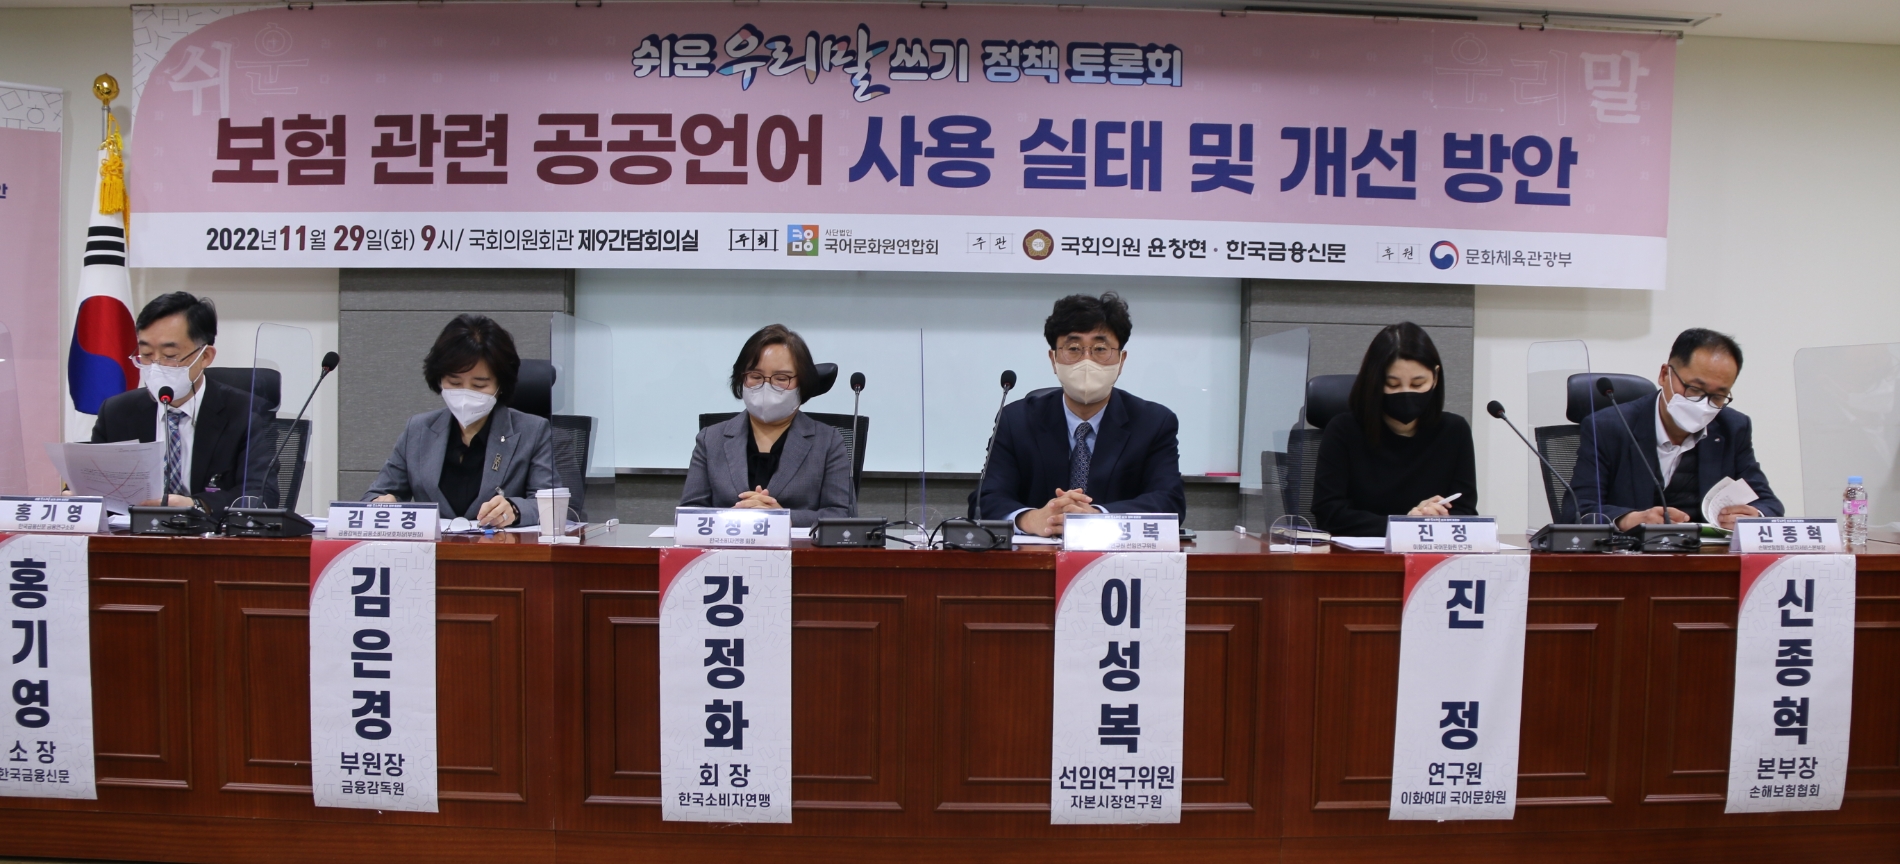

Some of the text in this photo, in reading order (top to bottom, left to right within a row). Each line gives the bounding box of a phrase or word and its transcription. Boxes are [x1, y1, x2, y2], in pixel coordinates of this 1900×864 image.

[631, 23, 1183, 102] 쉬운 우리말 쓰기 정책 토론회
[211, 112, 1579, 207] 보험 관련 공공언어 사용 실태 및 개선 방안
[468, 228, 575, 251] 국회의원회관
[577, 228, 699, 252] 제9간담회의실
[825, 228, 853, 237] 사단법인
[824, 238, 939, 256] 국어문화원연합회
[970, 234, 1010, 251] 주관
[1060, 236, 1141, 258] 국회의원
[1147, 237, 1207, 260] 윤창현
[1226, 239, 1347, 264] 한국금융신문
[1380, 244, 1415, 262] 후원
[1465, 248, 1573, 268] 문화체육관광부
[340, 751, 406, 777] 부원장
[1756, 756, 1819, 780] 본부장
[0, 767, 70, 783] 한국금융신문
[1058, 765, 1175, 790] 선임연구위원
[1428, 761, 1483, 786] 연구원
[341, 780, 405, 796] 금융감독원
[1749, 783, 1820, 799] 손해보험협회
[678, 791, 771, 808] 한국소비자연맹
[1070, 794, 1162, 810] 자본시장연구원
[1400, 790, 1507, 805] 이화여대 국어문화원
